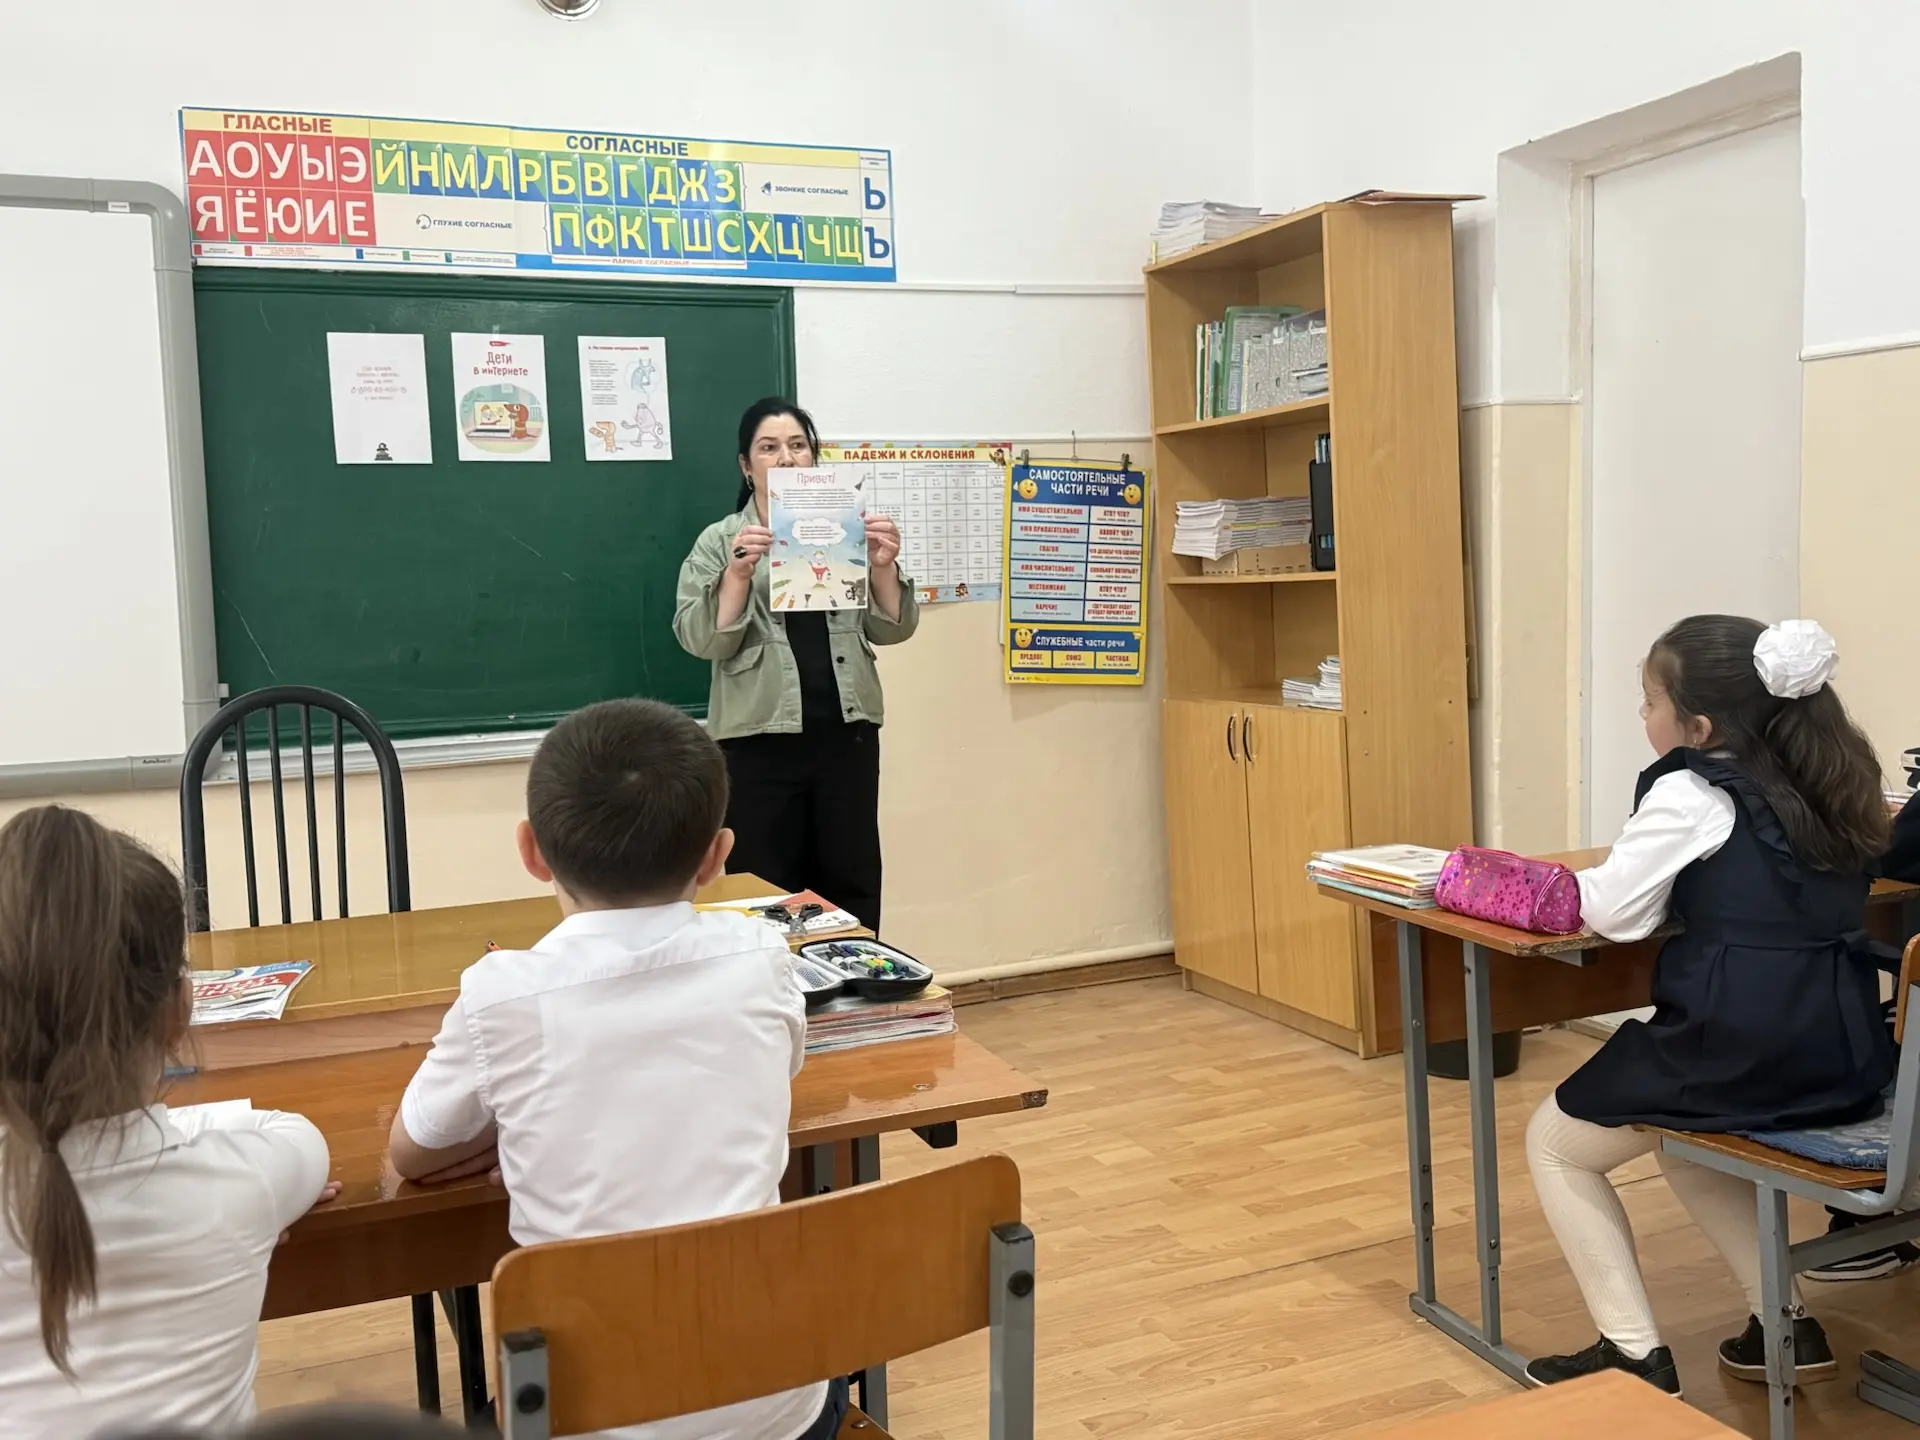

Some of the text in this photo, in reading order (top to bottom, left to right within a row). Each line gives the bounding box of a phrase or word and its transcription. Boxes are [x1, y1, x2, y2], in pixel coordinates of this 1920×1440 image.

[222, 113, 333, 134] ГЛАСНЫЕ
[566, 135, 689, 157] СОГЛАСНЫЕ
[775, 185, 849, 195] ЗВОНКИЕ СОГЛАСНЫЕ
[864, 177, 886, 210] Ь
[433, 219, 513, 229] ГЛУХИЕ СОГЛАСНЫЕ
[864, 226, 890, 258] Ъ
[486, 351, 513, 365] Дети
[482, 366, 528, 377] интернете
[844, 449, 975, 461] ПАДЕЖИ И СКЛОНЕНИЯ
[1029, 469, 1126, 485] САМОСТОЯТЕЛЬНЫЕ
[1051, 483, 1110, 496] ЧАСТИ РЕЧИ
[1035, 636, 1126, 648] СЛУЖЕБНЫЕ части речи
